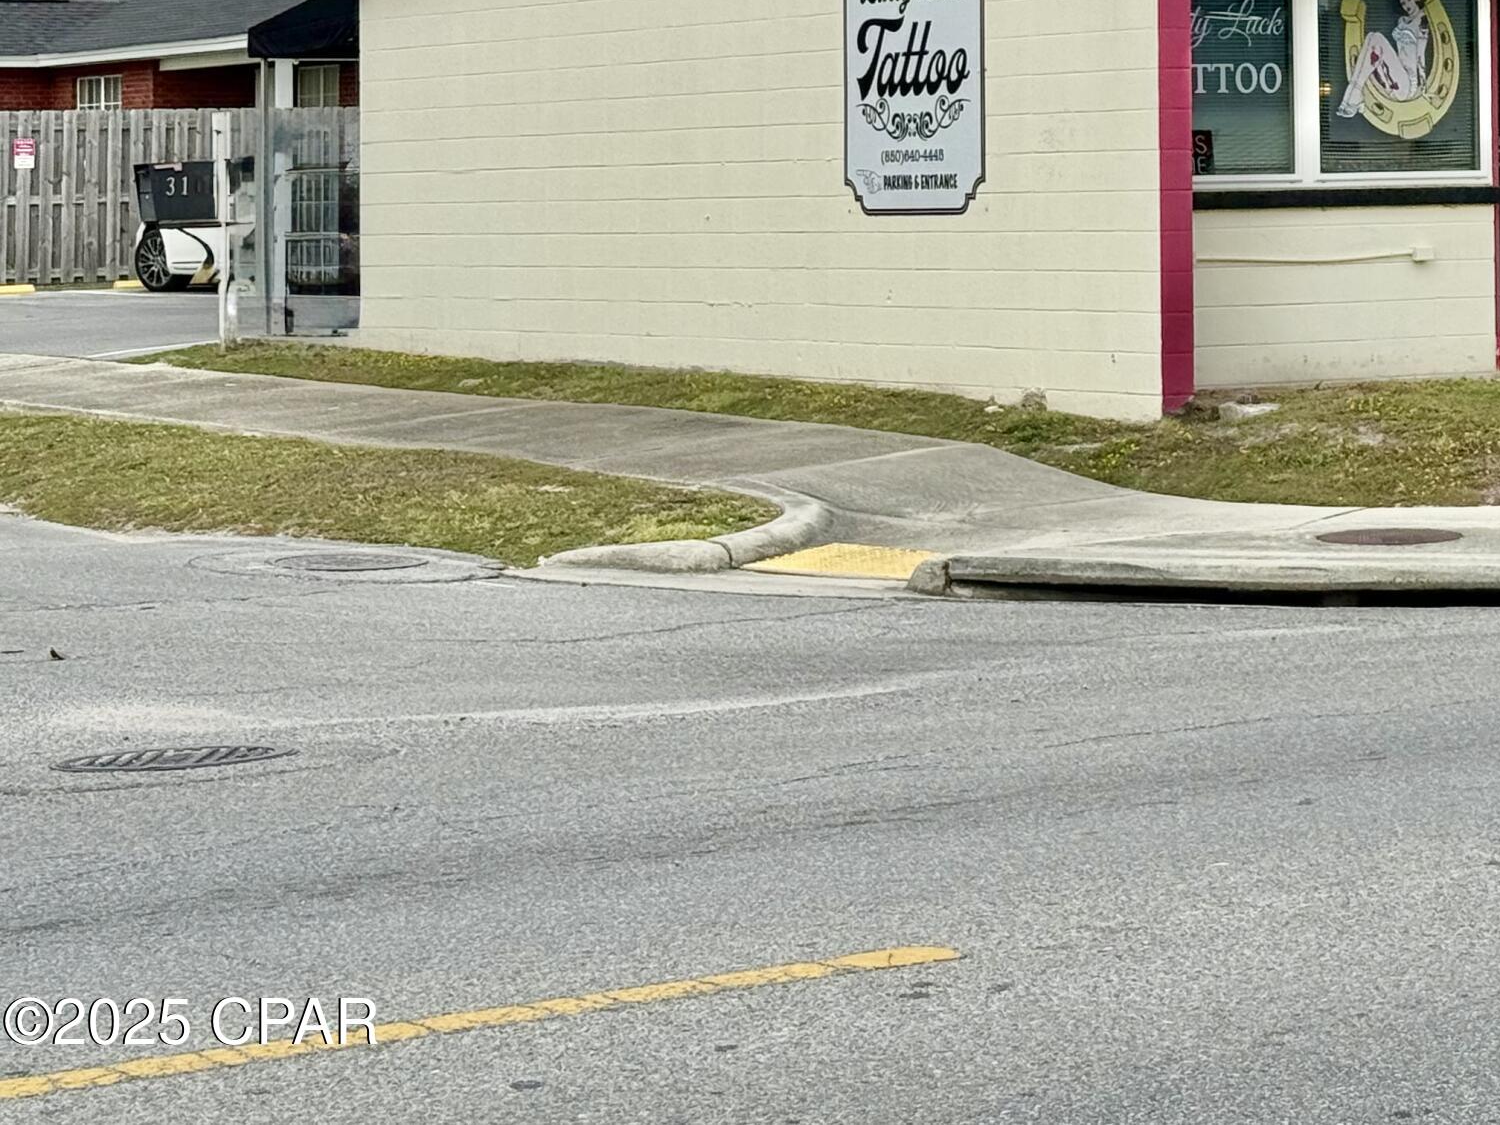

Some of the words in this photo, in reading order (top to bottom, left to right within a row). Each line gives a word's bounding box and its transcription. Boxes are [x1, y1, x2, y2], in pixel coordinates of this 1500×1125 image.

[856, 15, 970, 101] Tattoo
[165, 176, 188, 196] 31
[883, 174, 913, 191] PARKING
[914, 174, 920, 190] &
[920, 173, 958, 190] ENTRANCE
